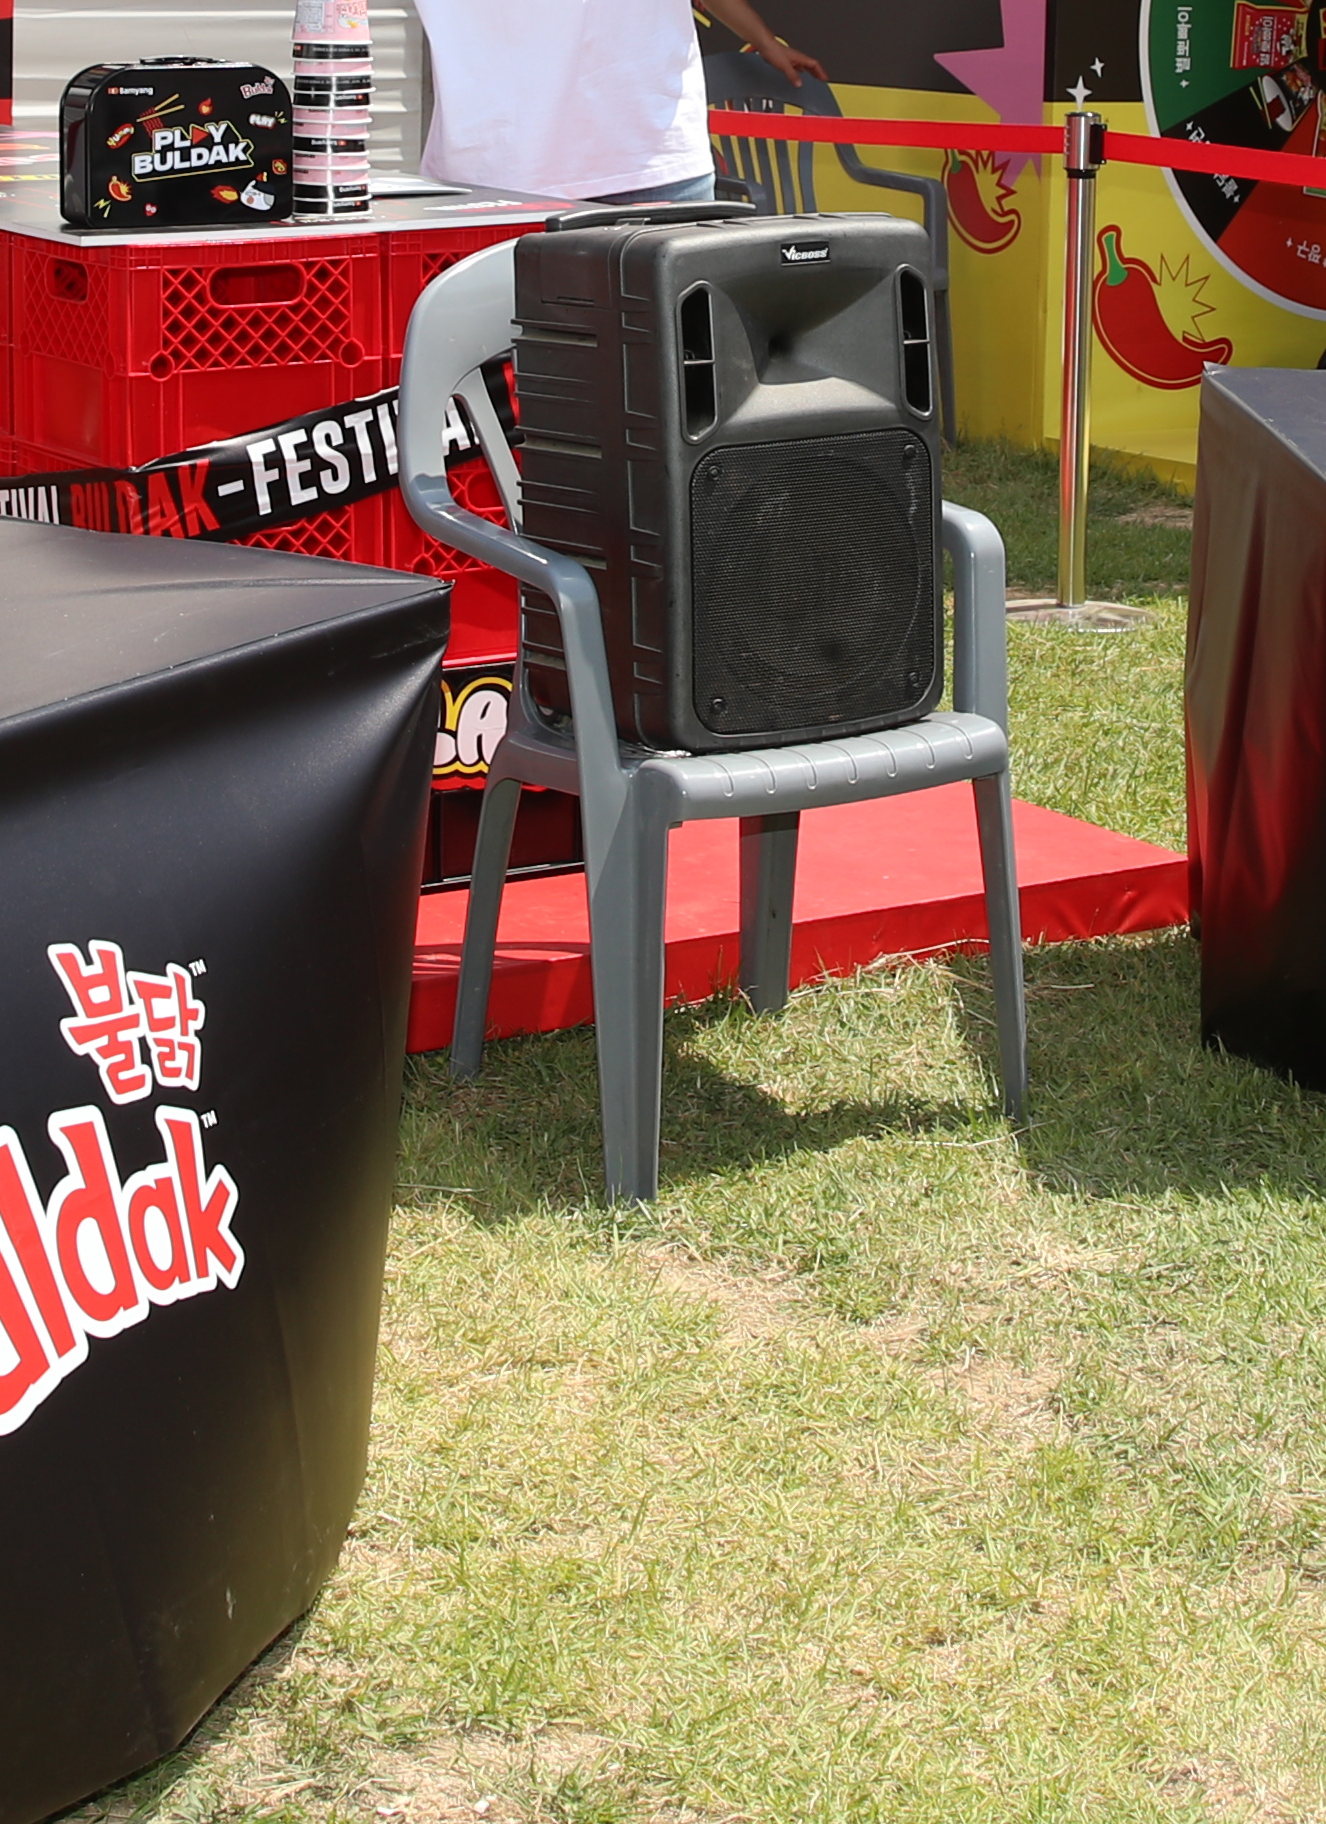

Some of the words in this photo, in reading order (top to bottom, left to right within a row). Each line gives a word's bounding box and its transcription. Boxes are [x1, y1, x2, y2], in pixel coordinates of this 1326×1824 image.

[1174, 6, 1193, 74] 별뽀빠이
[133, 141, 249, 175] BULDAK
[51, 941, 203, 1102] 불닭
